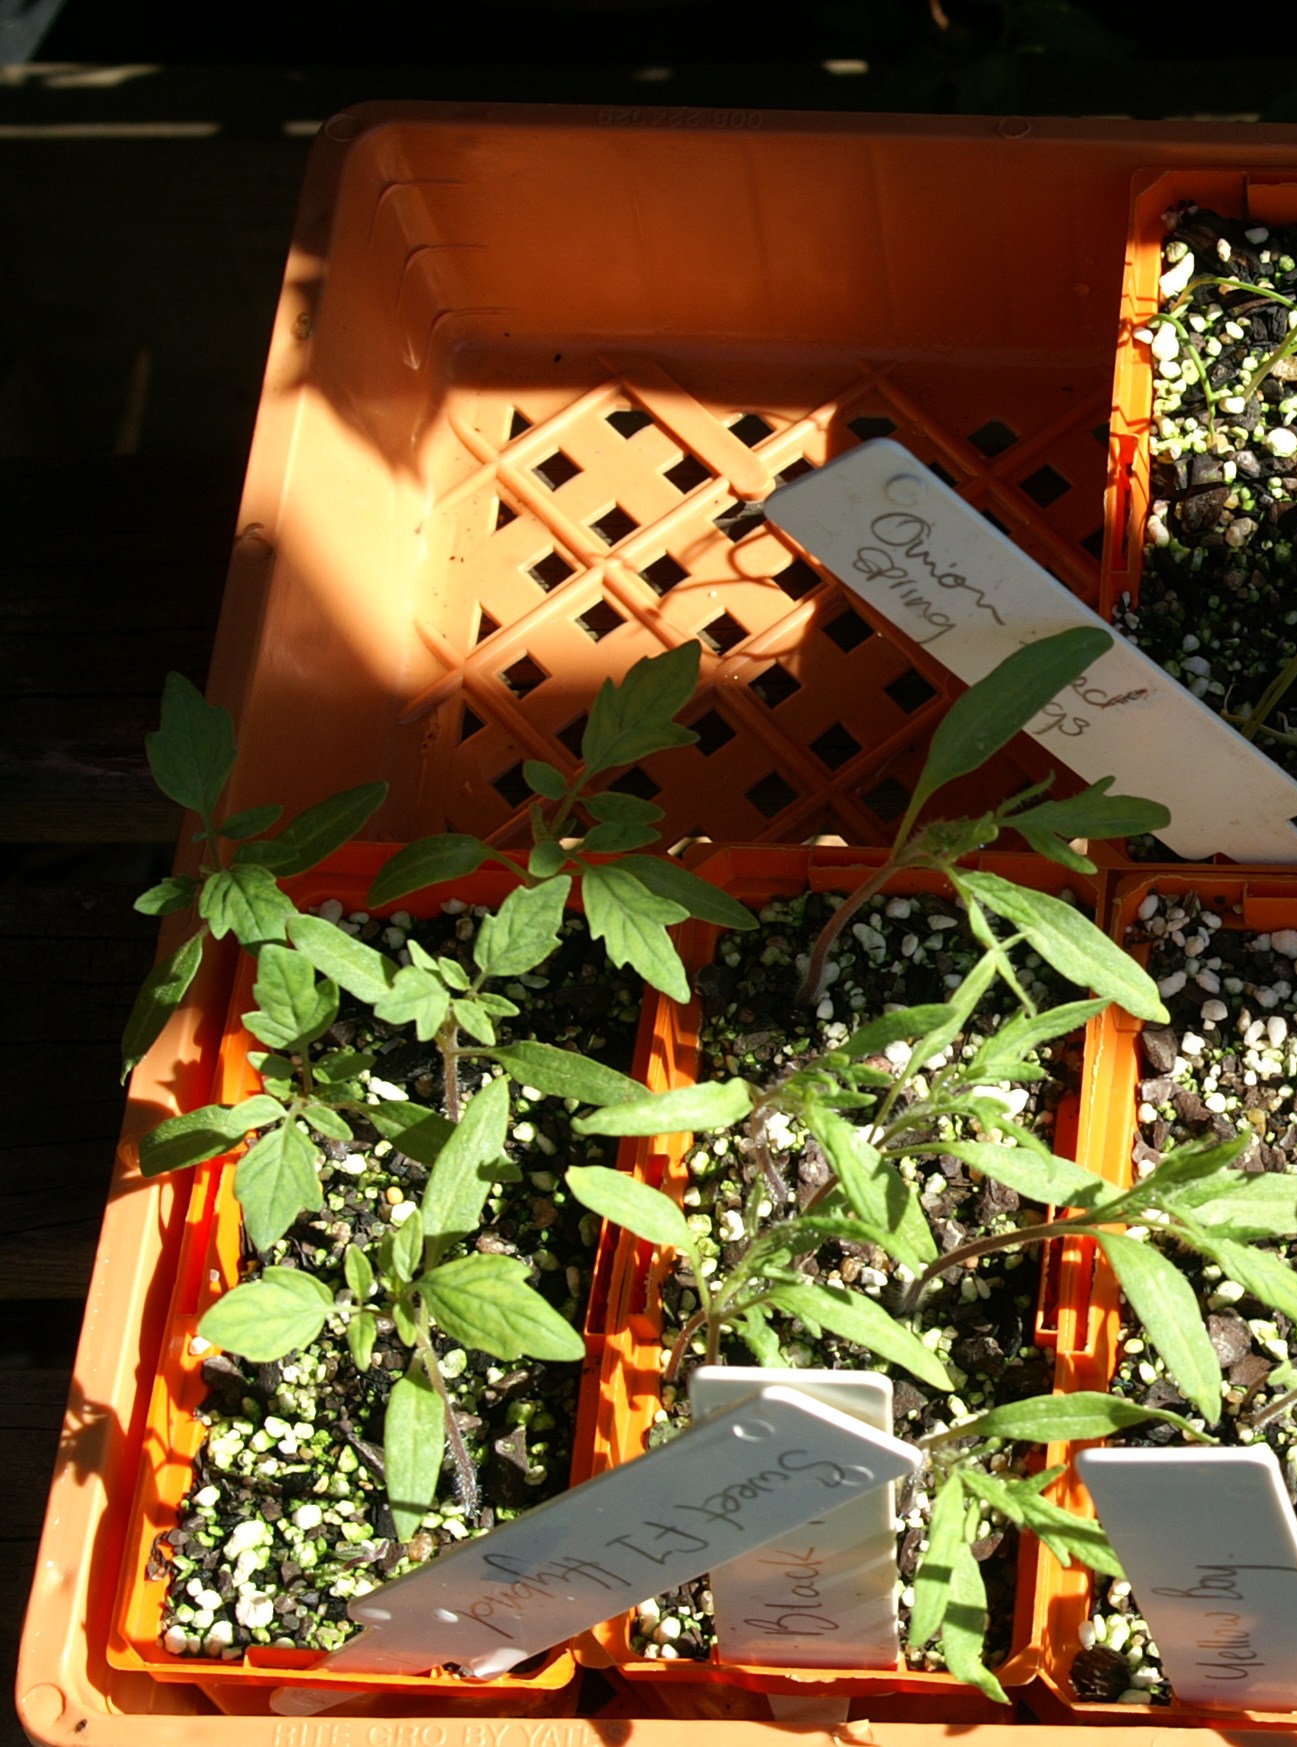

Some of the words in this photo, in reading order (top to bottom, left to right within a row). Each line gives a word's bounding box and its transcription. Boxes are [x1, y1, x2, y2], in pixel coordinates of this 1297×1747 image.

[869, 511, 1007, 627] Onion
[702, 1449, 847, 1532] Sweet
[605, 1503, 710, 1567] F1
[454, 1552, 633, 1640] Hybrid
[741, 1546, 840, 1638] Black
[1195, 1611, 1266, 1681] Yellow
[272, 1722, 352, 1747] RITE
[367, 1723, 449, 1747] GRO
[463, 1722, 511, 1747] BY
